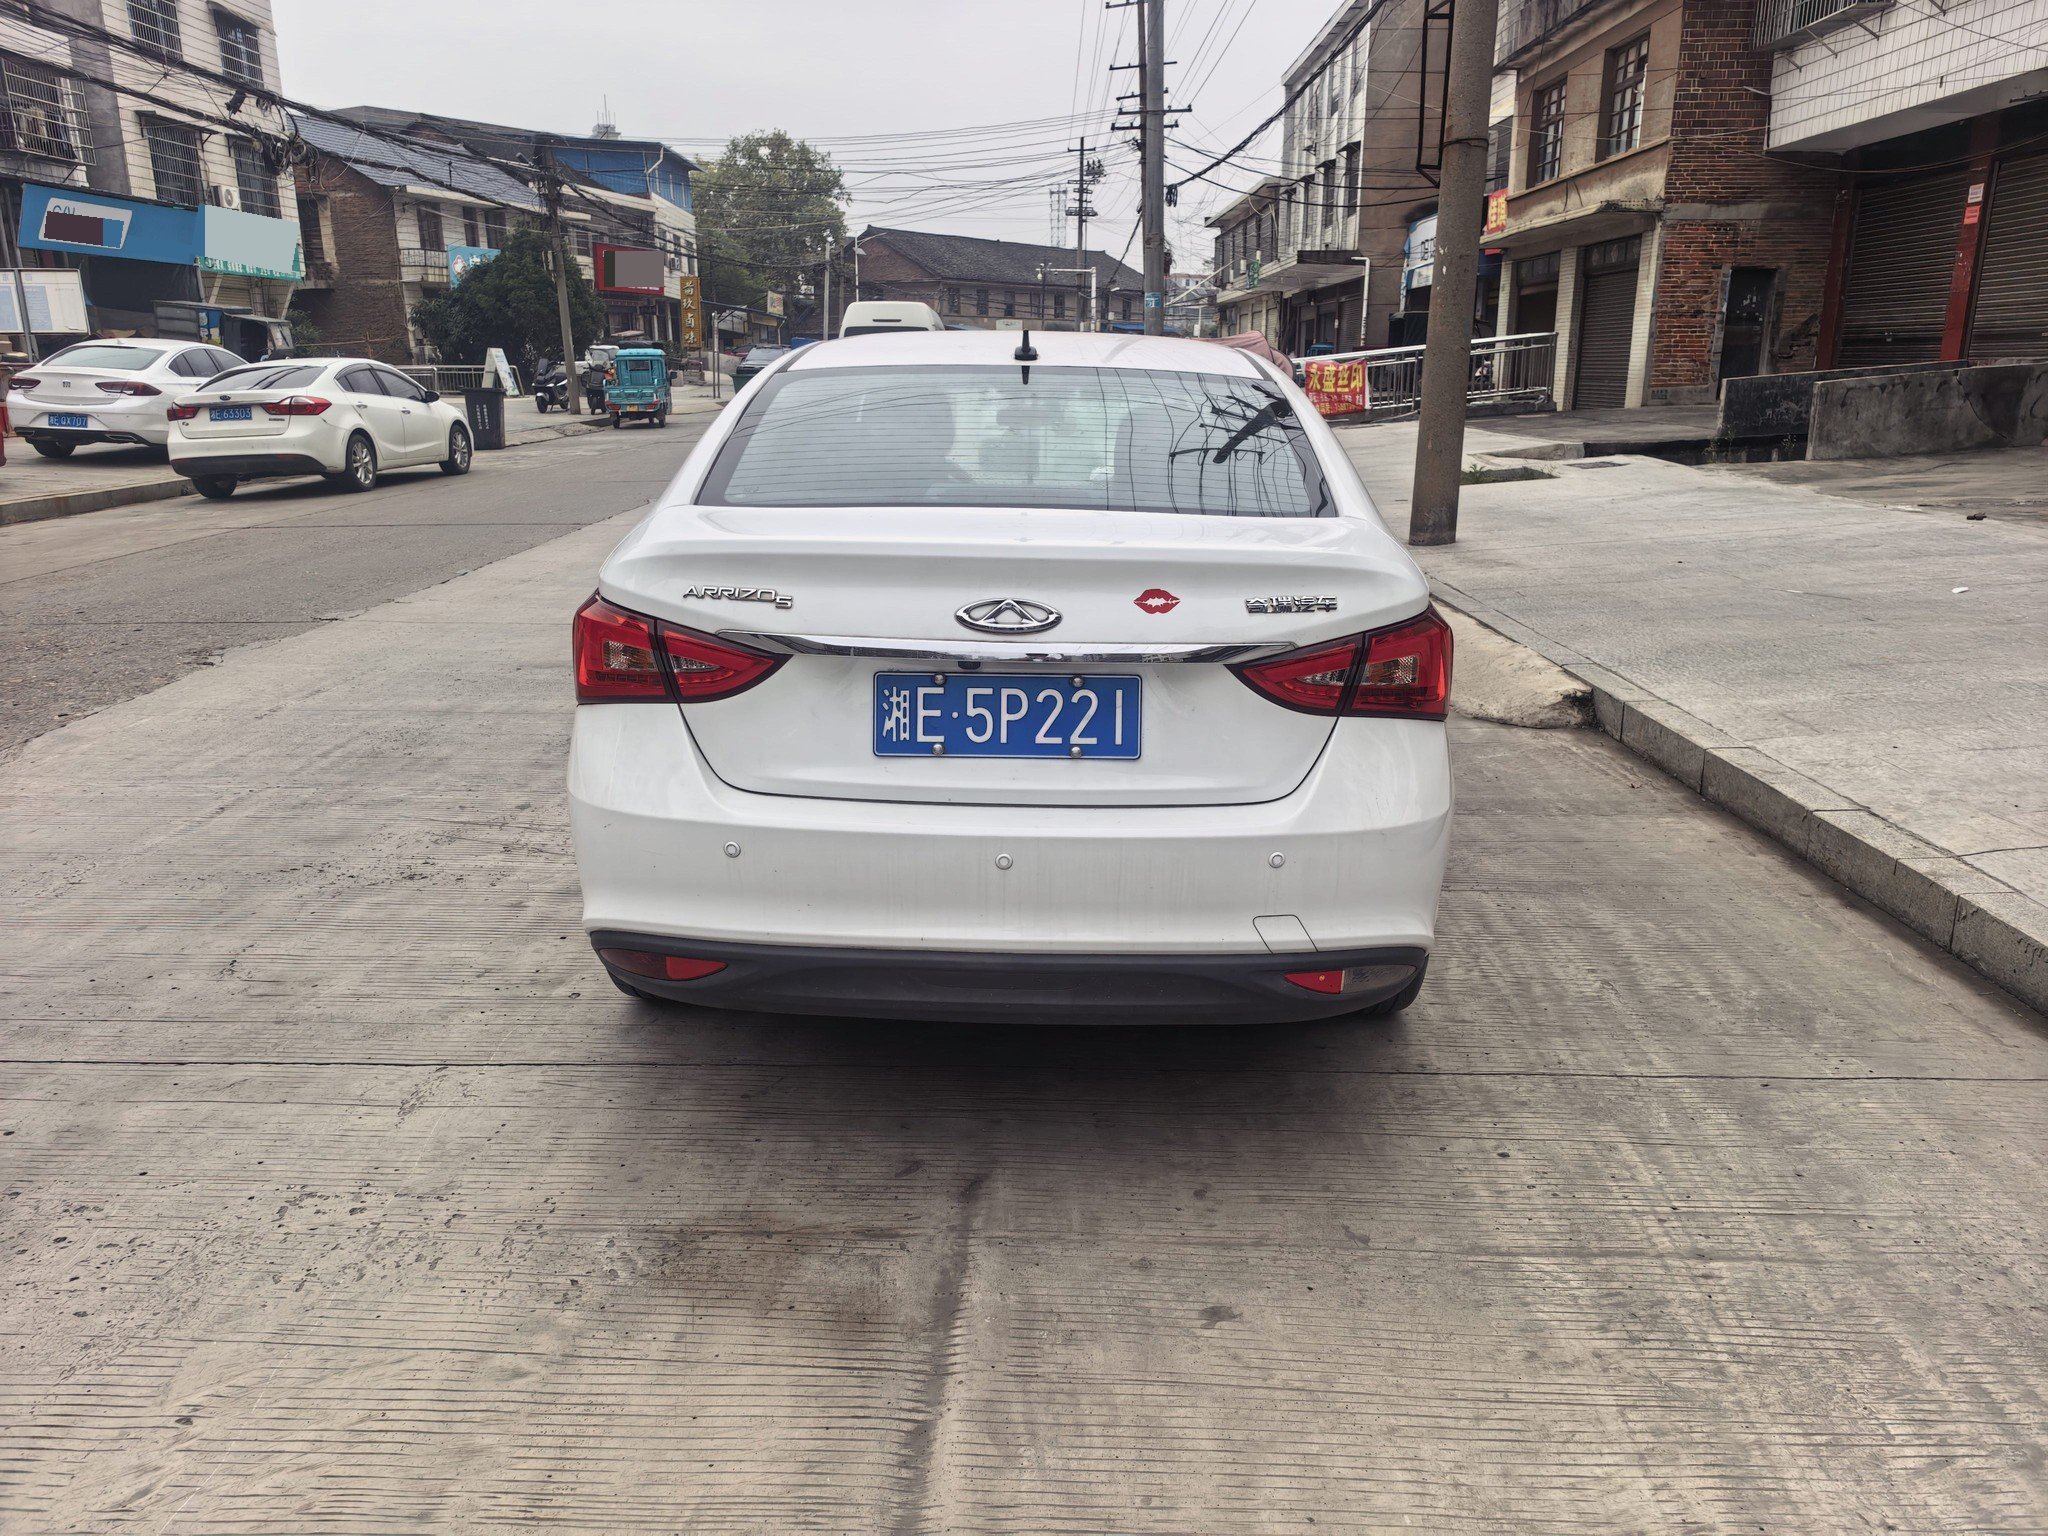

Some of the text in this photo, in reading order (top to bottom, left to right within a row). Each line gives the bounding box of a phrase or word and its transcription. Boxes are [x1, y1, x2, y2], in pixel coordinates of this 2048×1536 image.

[1309, 363, 1363, 392] 永盛丝印
[1246, 595, 1337, 613] 奇瑞汽车
